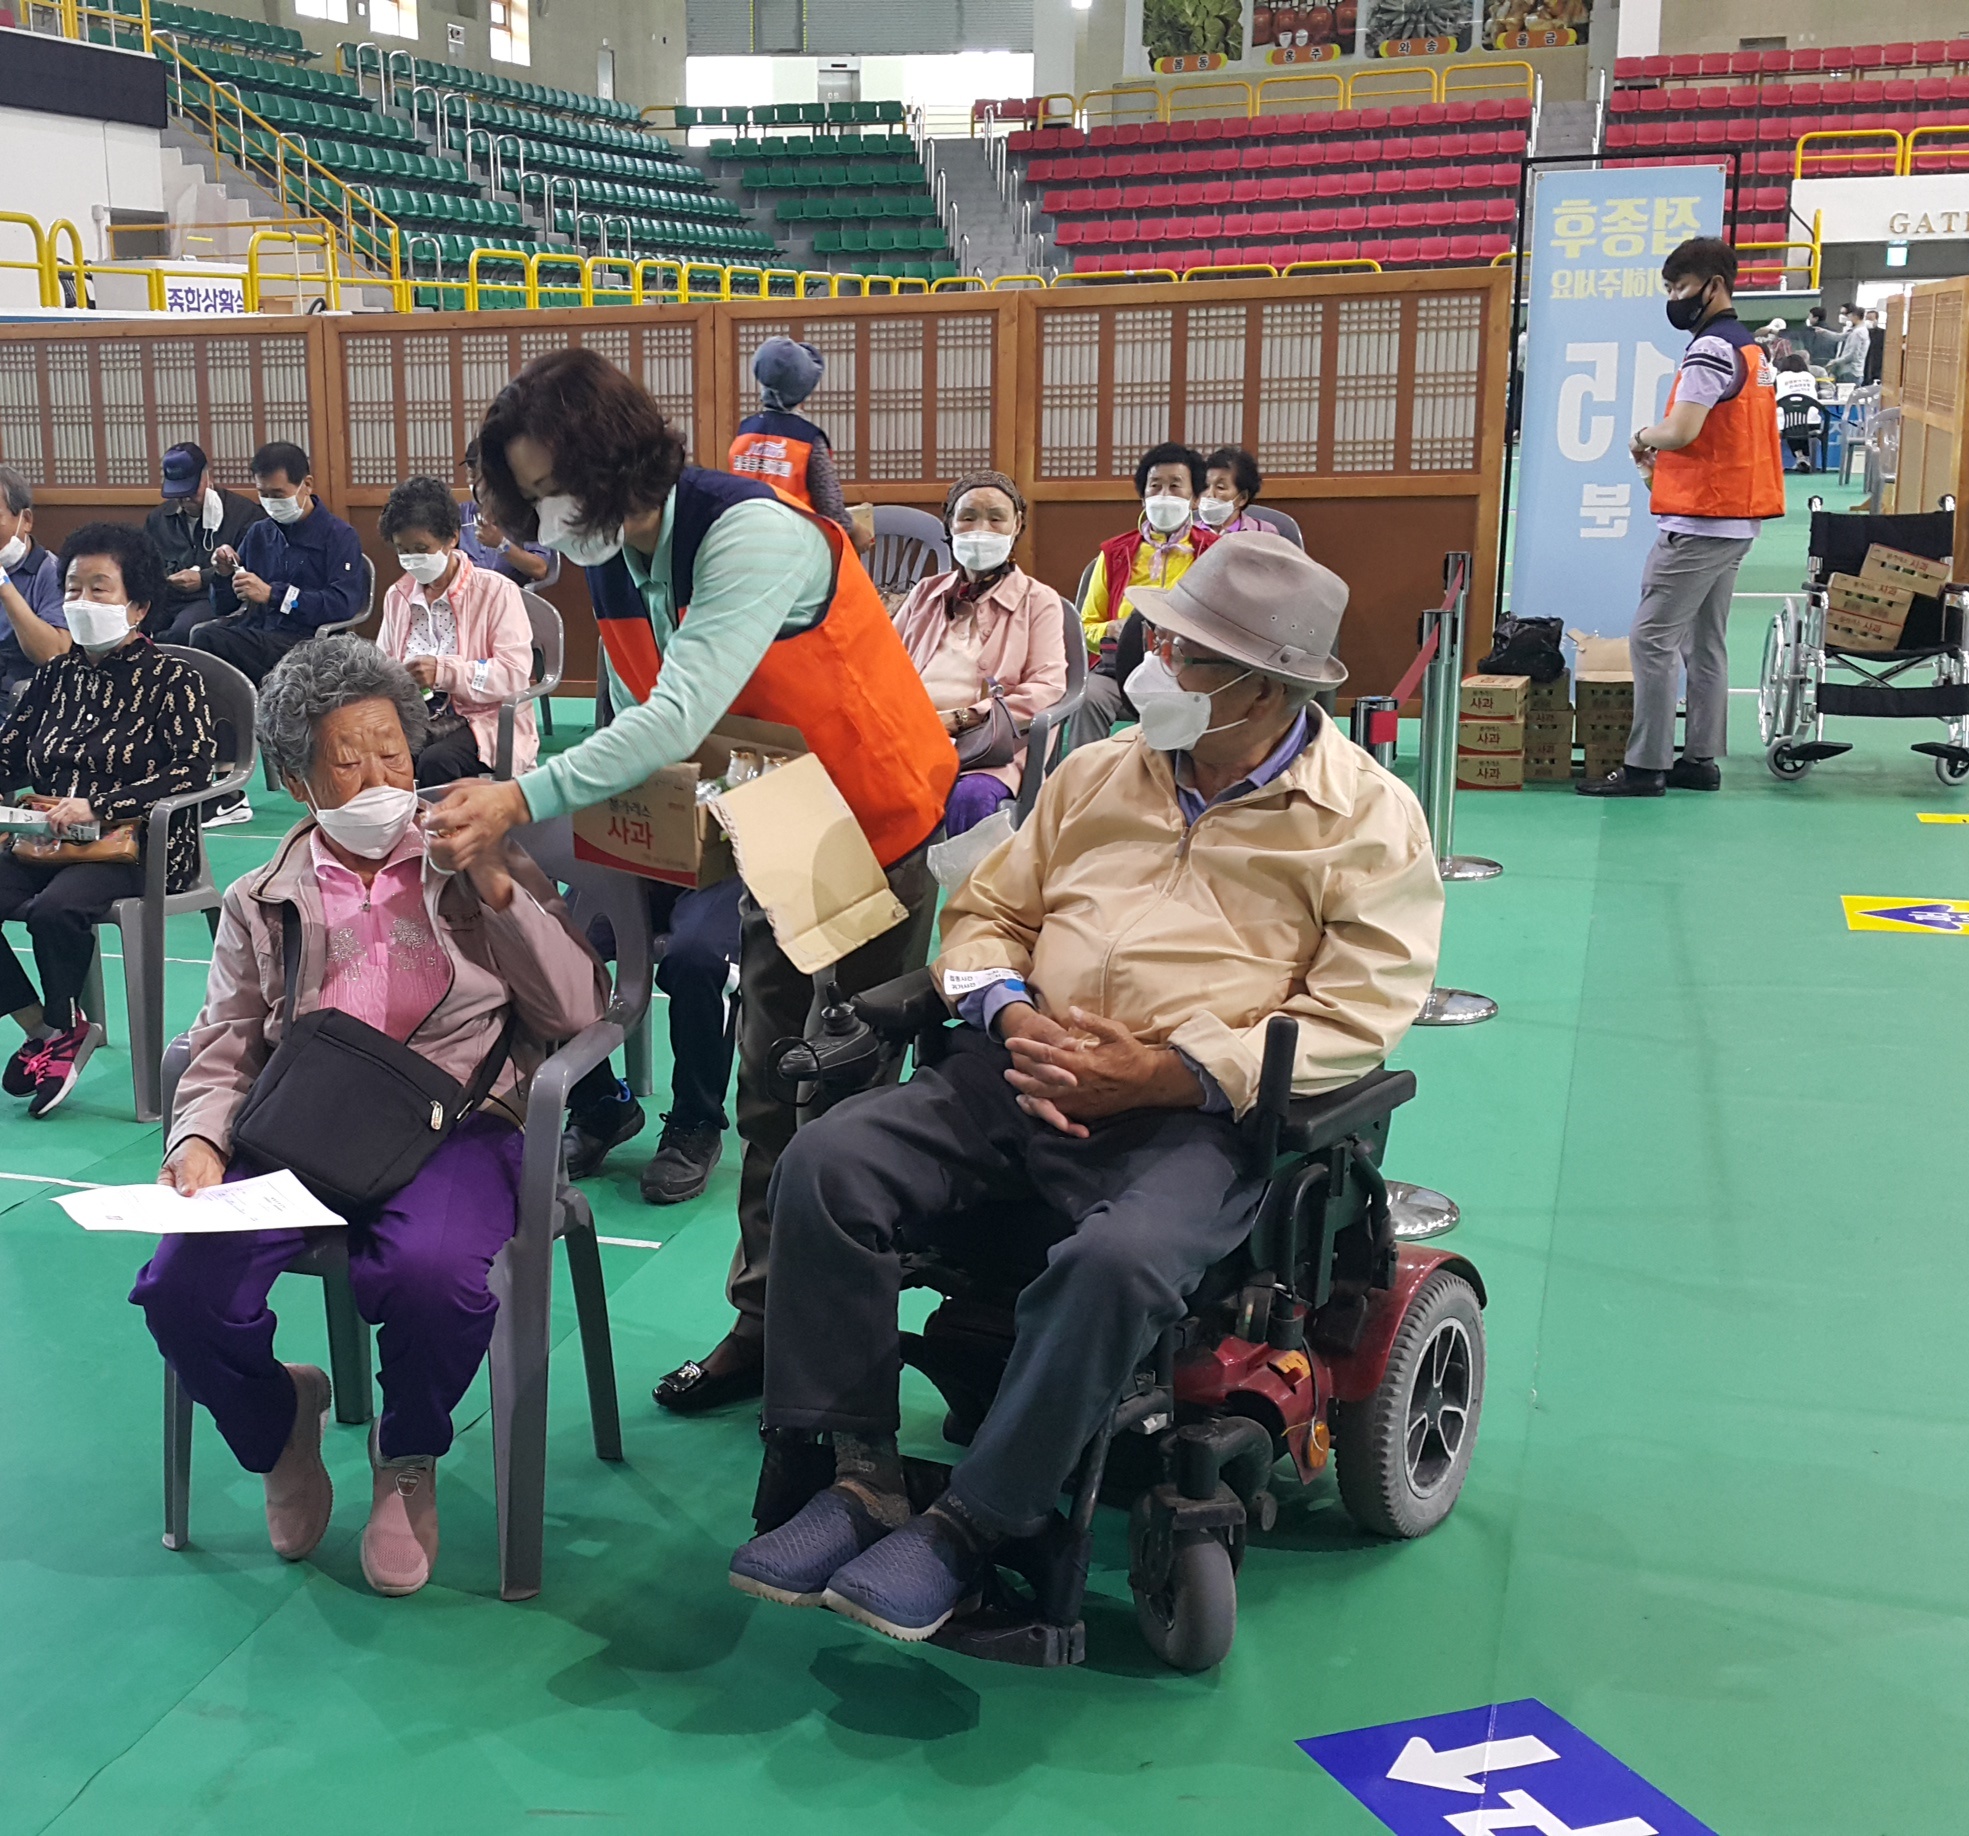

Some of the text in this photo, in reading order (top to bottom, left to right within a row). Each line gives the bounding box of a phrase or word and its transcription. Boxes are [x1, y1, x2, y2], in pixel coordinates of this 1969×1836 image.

[1889, 211, 1969, 234] GAT
[1470, 697, 1494, 709] 사과
[1477, 732, 1501, 745] 사과
[1476, 766, 1501, 779] 사과
[607, 816, 654, 850] 사과
